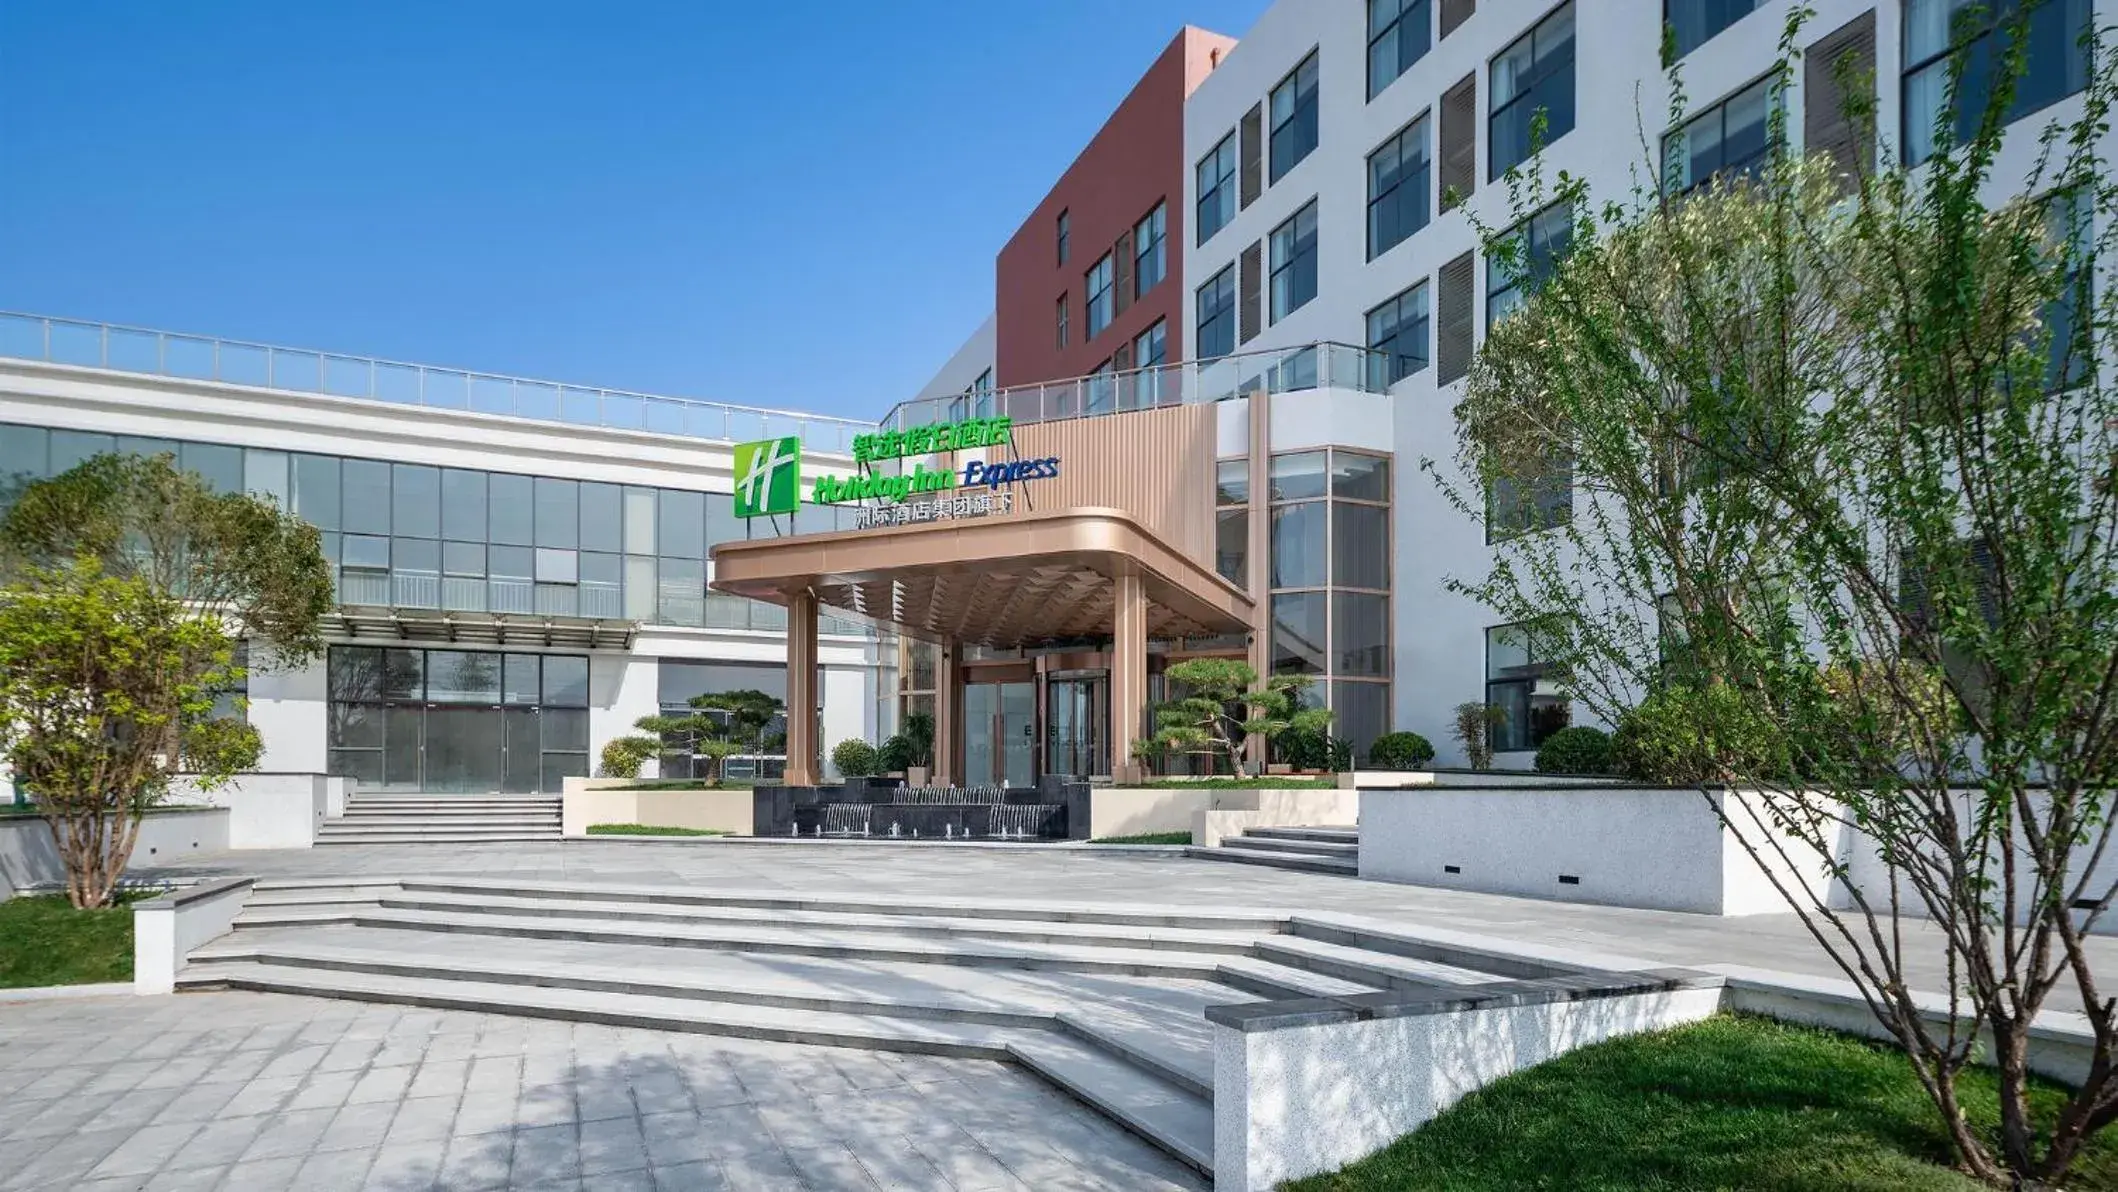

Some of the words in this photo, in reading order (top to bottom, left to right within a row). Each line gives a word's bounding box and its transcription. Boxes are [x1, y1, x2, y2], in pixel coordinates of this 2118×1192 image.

[853, 417, 1012, 463] 智选假日酒店
[812, 471, 911, 504] Holiday
[911, 463, 956, 492] Inn
[964, 457, 1060, 490] Express
[854, 493, 1013, 529] 洲际酒店集团旗下
